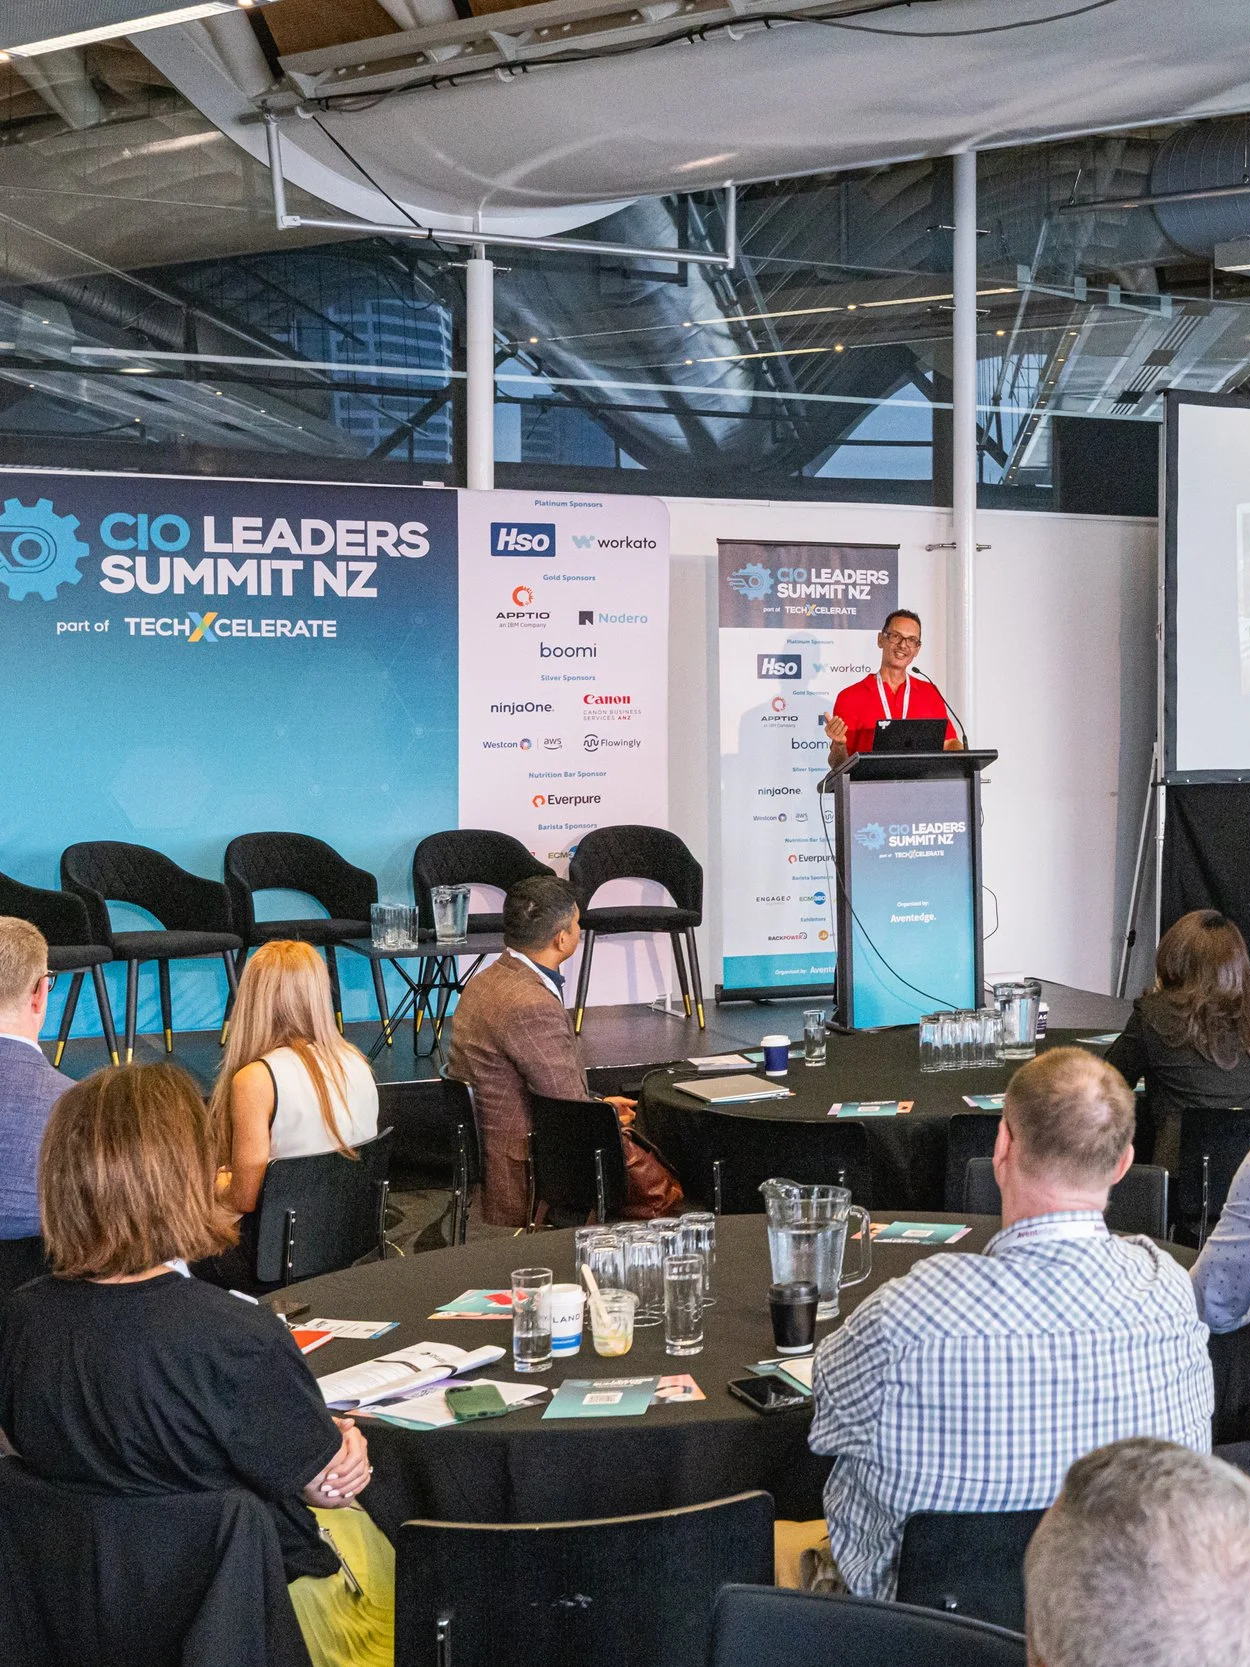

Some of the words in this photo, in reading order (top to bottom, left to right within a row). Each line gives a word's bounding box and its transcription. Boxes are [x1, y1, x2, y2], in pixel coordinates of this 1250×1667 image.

[100, 512, 191, 552] CIO
[203, 516, 430, 558] LEADERS
[598, 536, 657, 550] workato
[100, 555, 303, 596] SUMMIT
[313, 561, 377, 598] NZ
[562, 574, 596, 582] Sponsors
[777, 568, 807, 582] CIO
[811, 568, 889, 585] LEADERS
[777, 583, 845, 599] SUMMIT
[848, 585, 871, 600] NZ
[495, 612, 550, 620] APPTIO
[785, 604, 857, 617] TECHXCELERATE
[598, 613, 648, 624] Nodero
[56, 619, 90, 636] part
[94, 618, 109, 633] of
[124, 611, 337, 643] TECHXCELERATE
[540, 642, 597, 658] boomi
[830, 664, 872, 672] workato
[562, 674, 596, 682] Sponsors
[583, 694, 631, 705] Canon
[483, 741, 518, 749] Westcon
[543, 738, 562, 746] aws
[600, 738, 641, 748] Flowingly
[791, 738, 830, 749] boom
[577, 770, 607, 779] Sponsor
[548, 795, 601, 807] Everpure
[564, 823, 598, 831] Sponsors
[888, 824, 909, 834] CIO
[912, 821, 965, 834] LEADERS
[888, 834, 936, 846] SUMMIT
[938, 834, 953, 844] NZ
